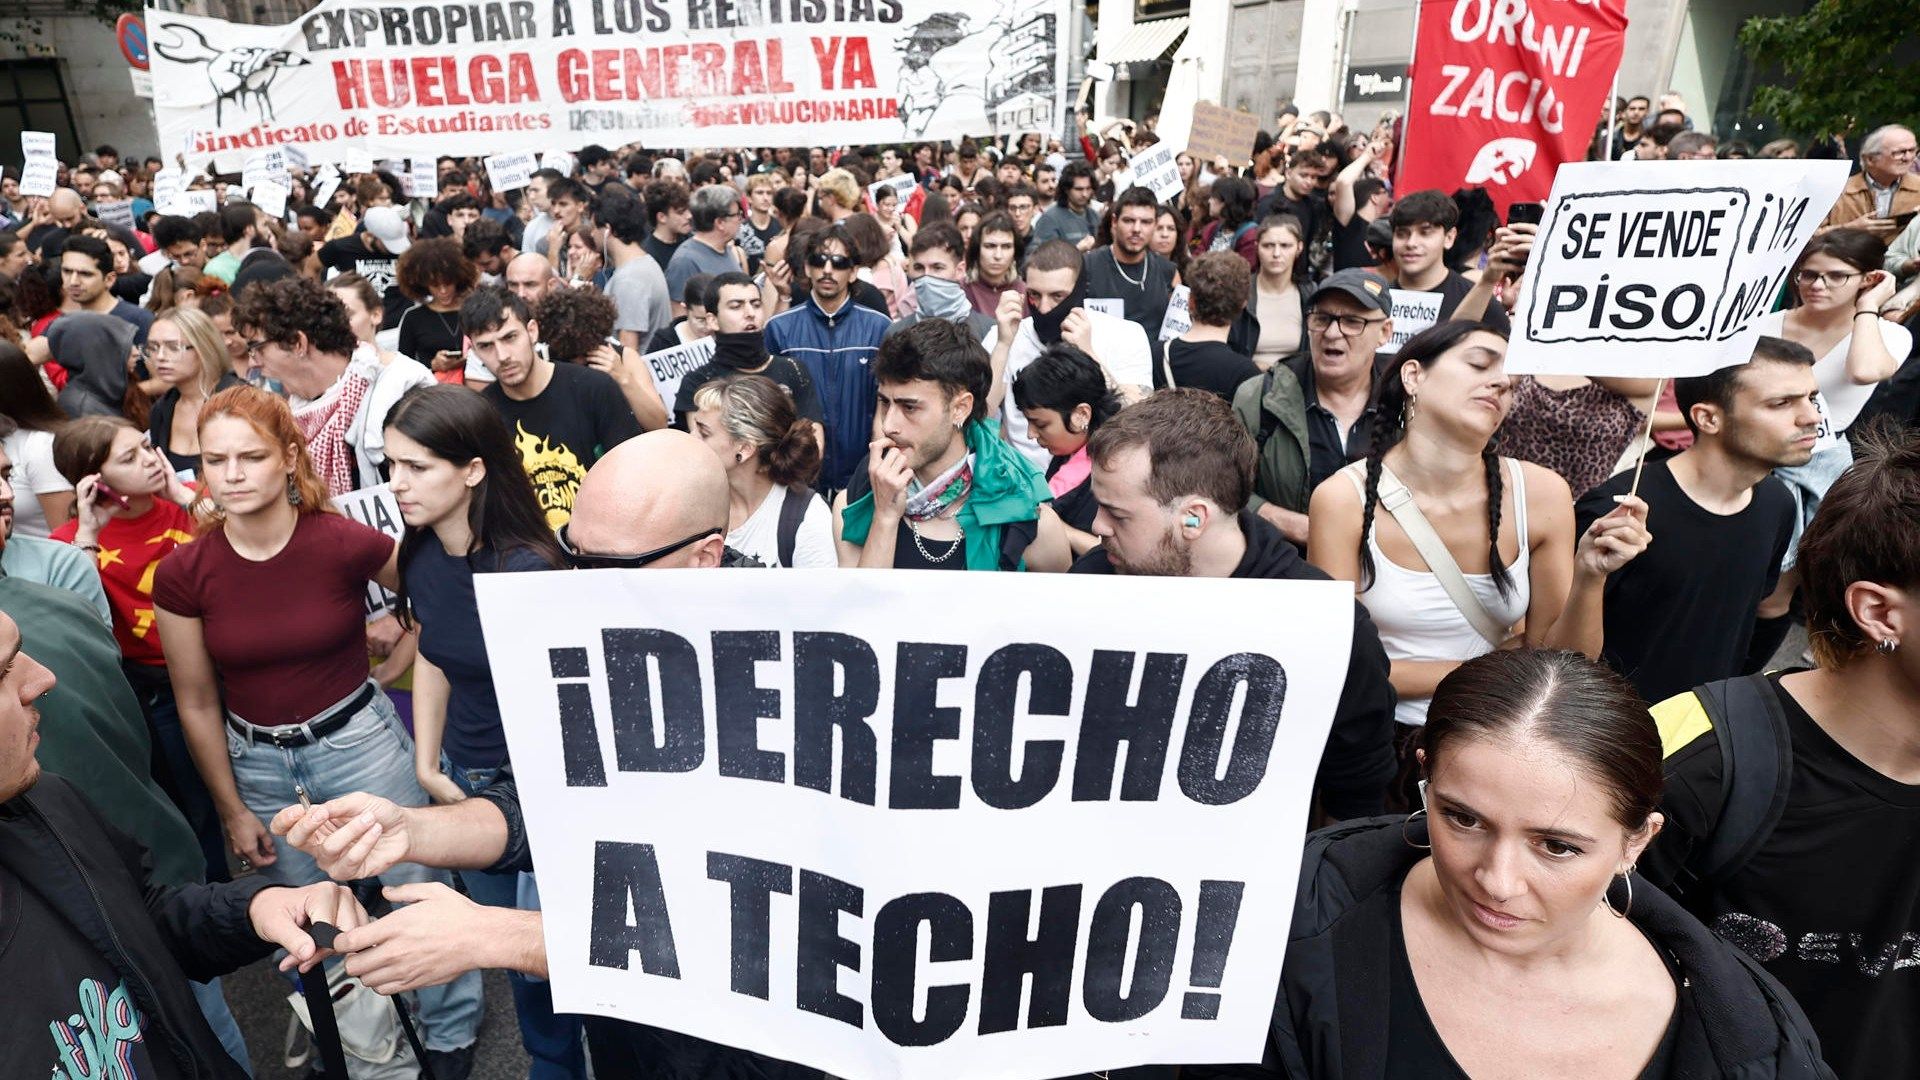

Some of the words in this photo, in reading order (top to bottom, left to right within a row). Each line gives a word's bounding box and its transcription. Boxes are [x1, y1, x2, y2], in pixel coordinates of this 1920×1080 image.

[302, 0, 537, 50] EXPROPIAR
[552, 0, 575, 37] A
[593, 0, 671, 34] LOS
[332, 52, 541, 110] HUELGA
[557, 39, 794, 103] GENERAL
[811, 36, 877, 90] YA
[193, 119, 337, 153] Sindicato
[344, 116, 369, 137] de
[377, 109, 552, 135] Estudiantes
[1562, 212, 1611, 260] SE
[1618, 210, 1726, 258] VENDE
[1392, 302, 1436, 321] erechos
[548, 627, 1288, 810] ¡DERECHO
[589, 840, 681, 980] A
[706, 849, 1246, 1048] TECHO!
